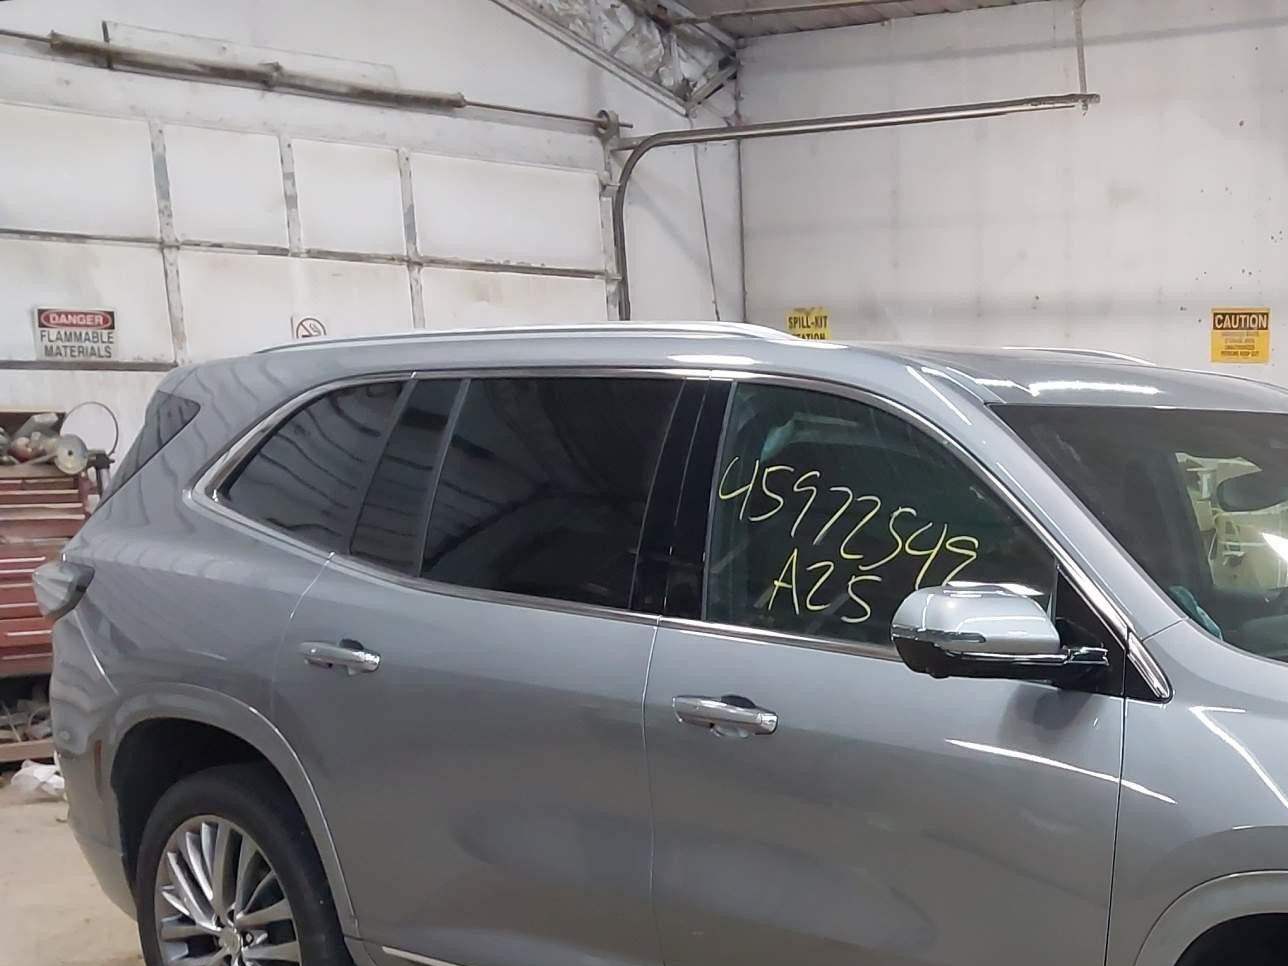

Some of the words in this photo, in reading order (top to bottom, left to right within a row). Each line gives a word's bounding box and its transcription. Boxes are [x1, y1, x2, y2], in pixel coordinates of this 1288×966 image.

[49, 313, 104, 326] DANGER
[788, 315, 828, 329] SPILL-KIT
[1214, 314, 1268, 329] CAUTION
[40, 330, 114, 344] FLAMMABLE
[44, 345, 112, 358] MATERIALS
[719, 456, 979, 591] 45972549
[768, 548, 882, 623] A25
